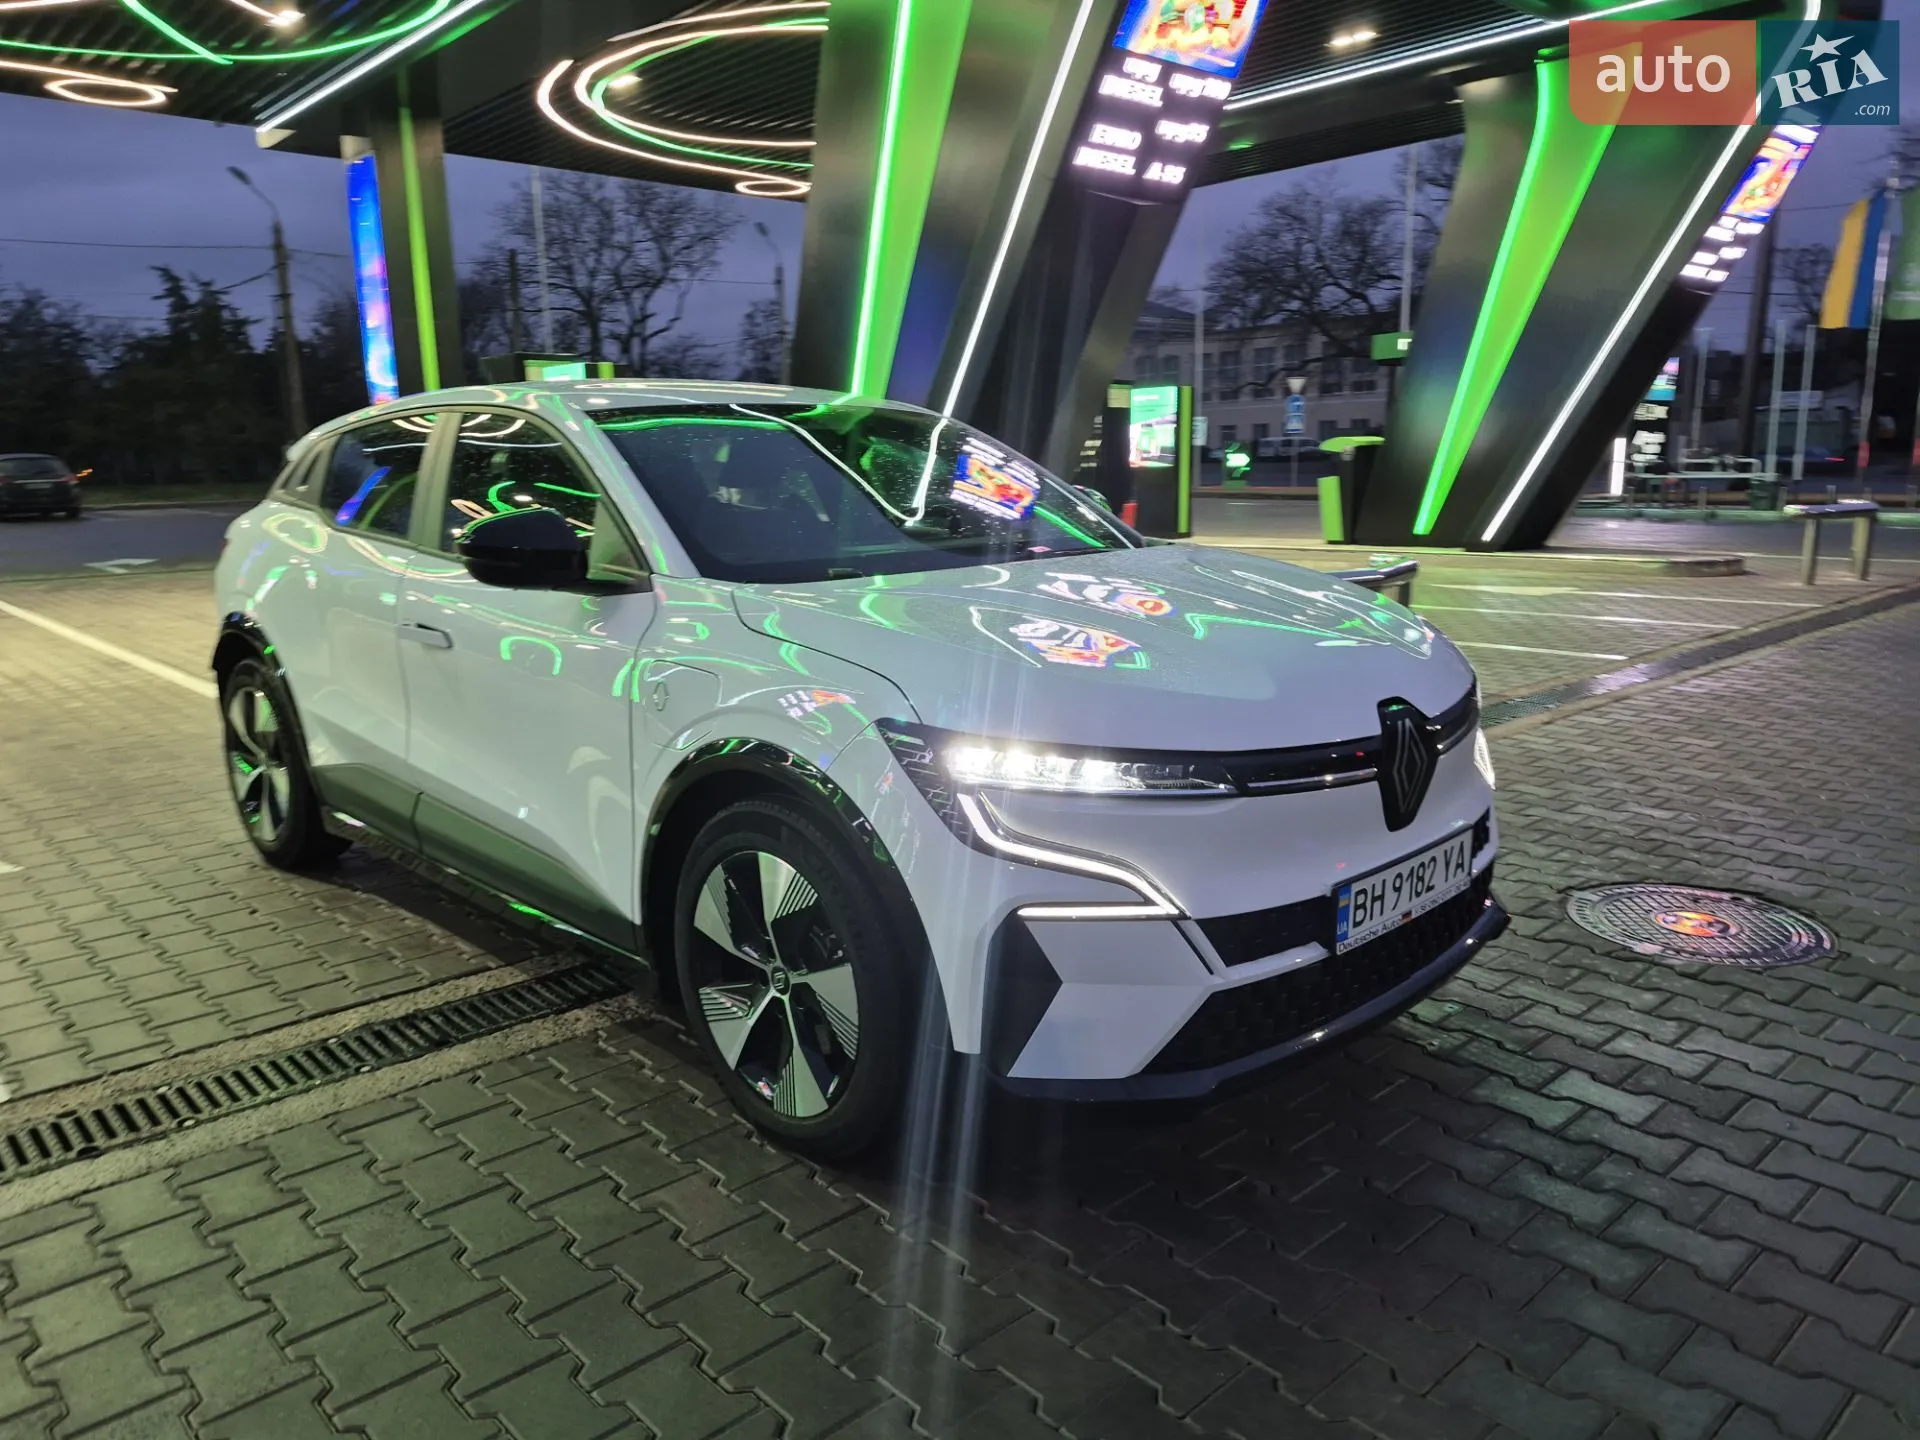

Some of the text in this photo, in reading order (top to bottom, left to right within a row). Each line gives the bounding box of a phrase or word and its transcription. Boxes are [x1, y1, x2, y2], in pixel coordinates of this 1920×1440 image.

[1352, 878, 1387, 930] BH
[1391, 855, 1438, 912] 9182
[1444, 840, 1466, 883] YA
[1337, 920, 1348, 936] UA
